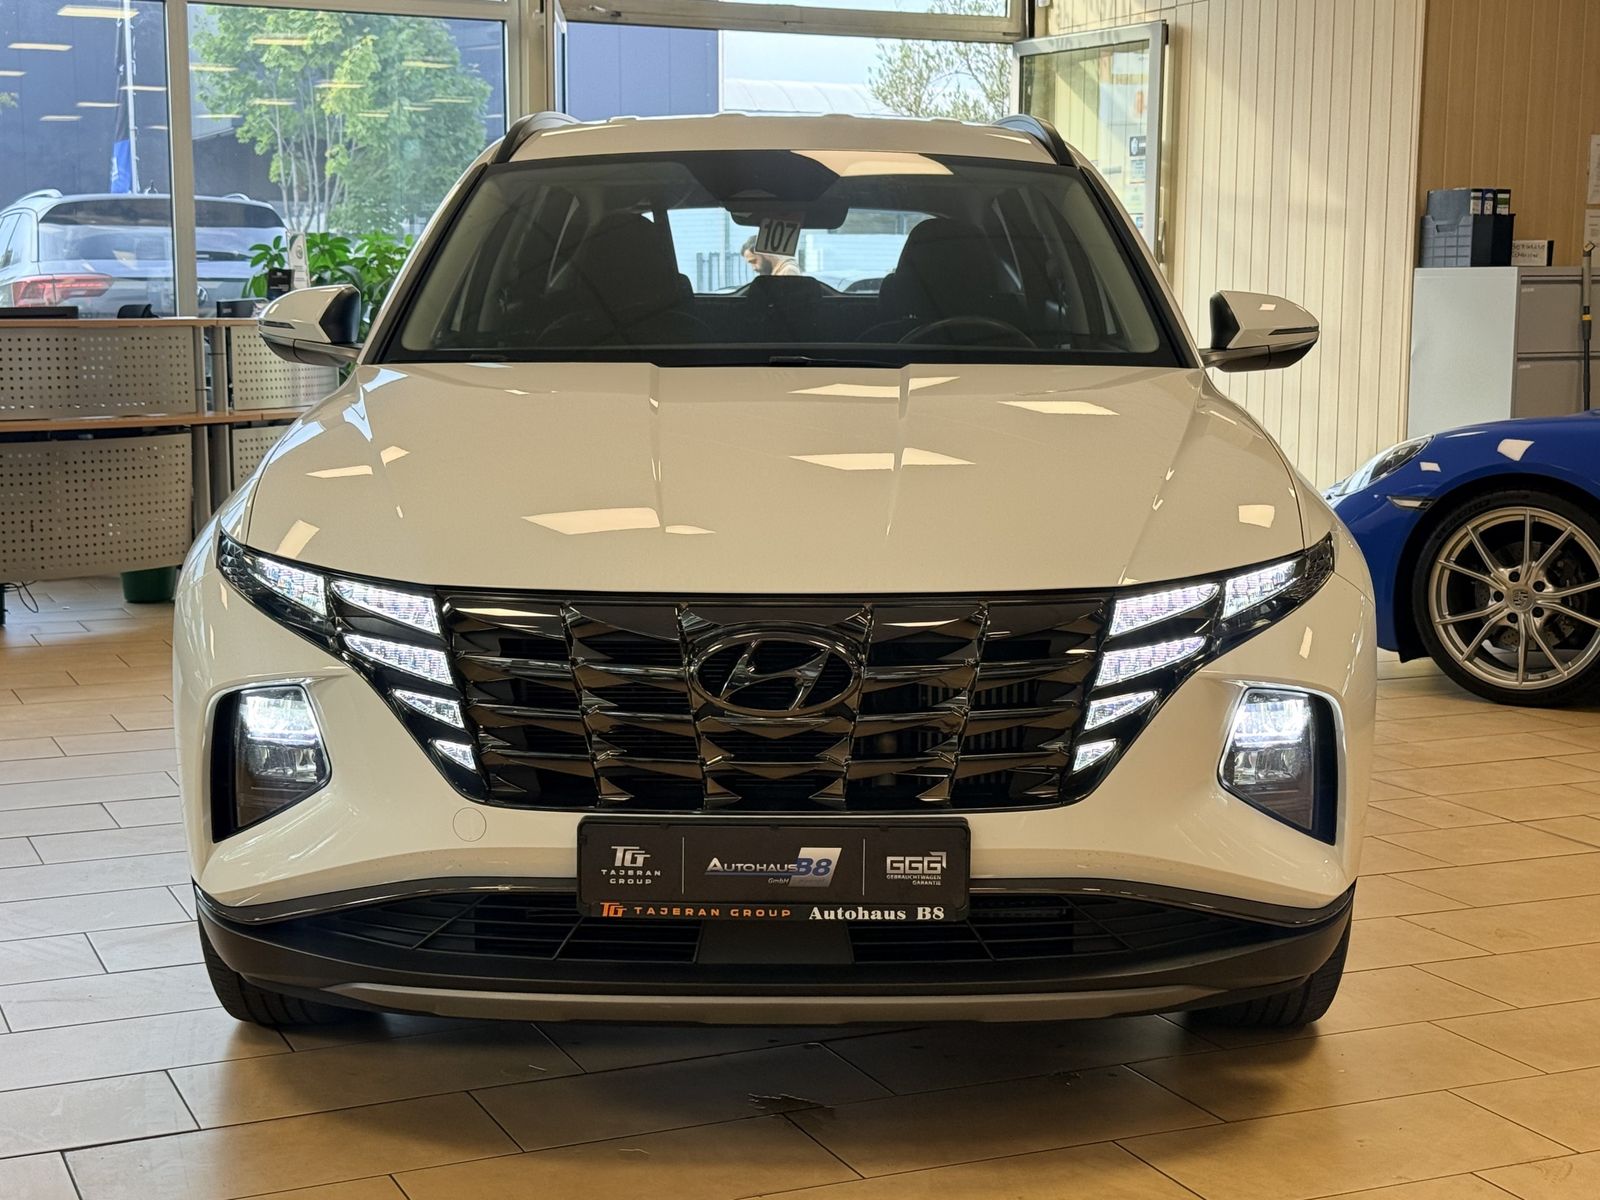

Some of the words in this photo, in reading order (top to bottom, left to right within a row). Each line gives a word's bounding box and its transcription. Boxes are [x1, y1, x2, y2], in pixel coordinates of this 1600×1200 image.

[764, 218, 798, 253] 107
[796, 858, 832, 876] B8
[886, 856, 942, 875] GGG
[634, 906, 720, 917] TAJERAN
[730, 908, 791, 918] GROUP
[809, 906, 907, 921] Autohaus
[916, 907, 945, 921] B8
